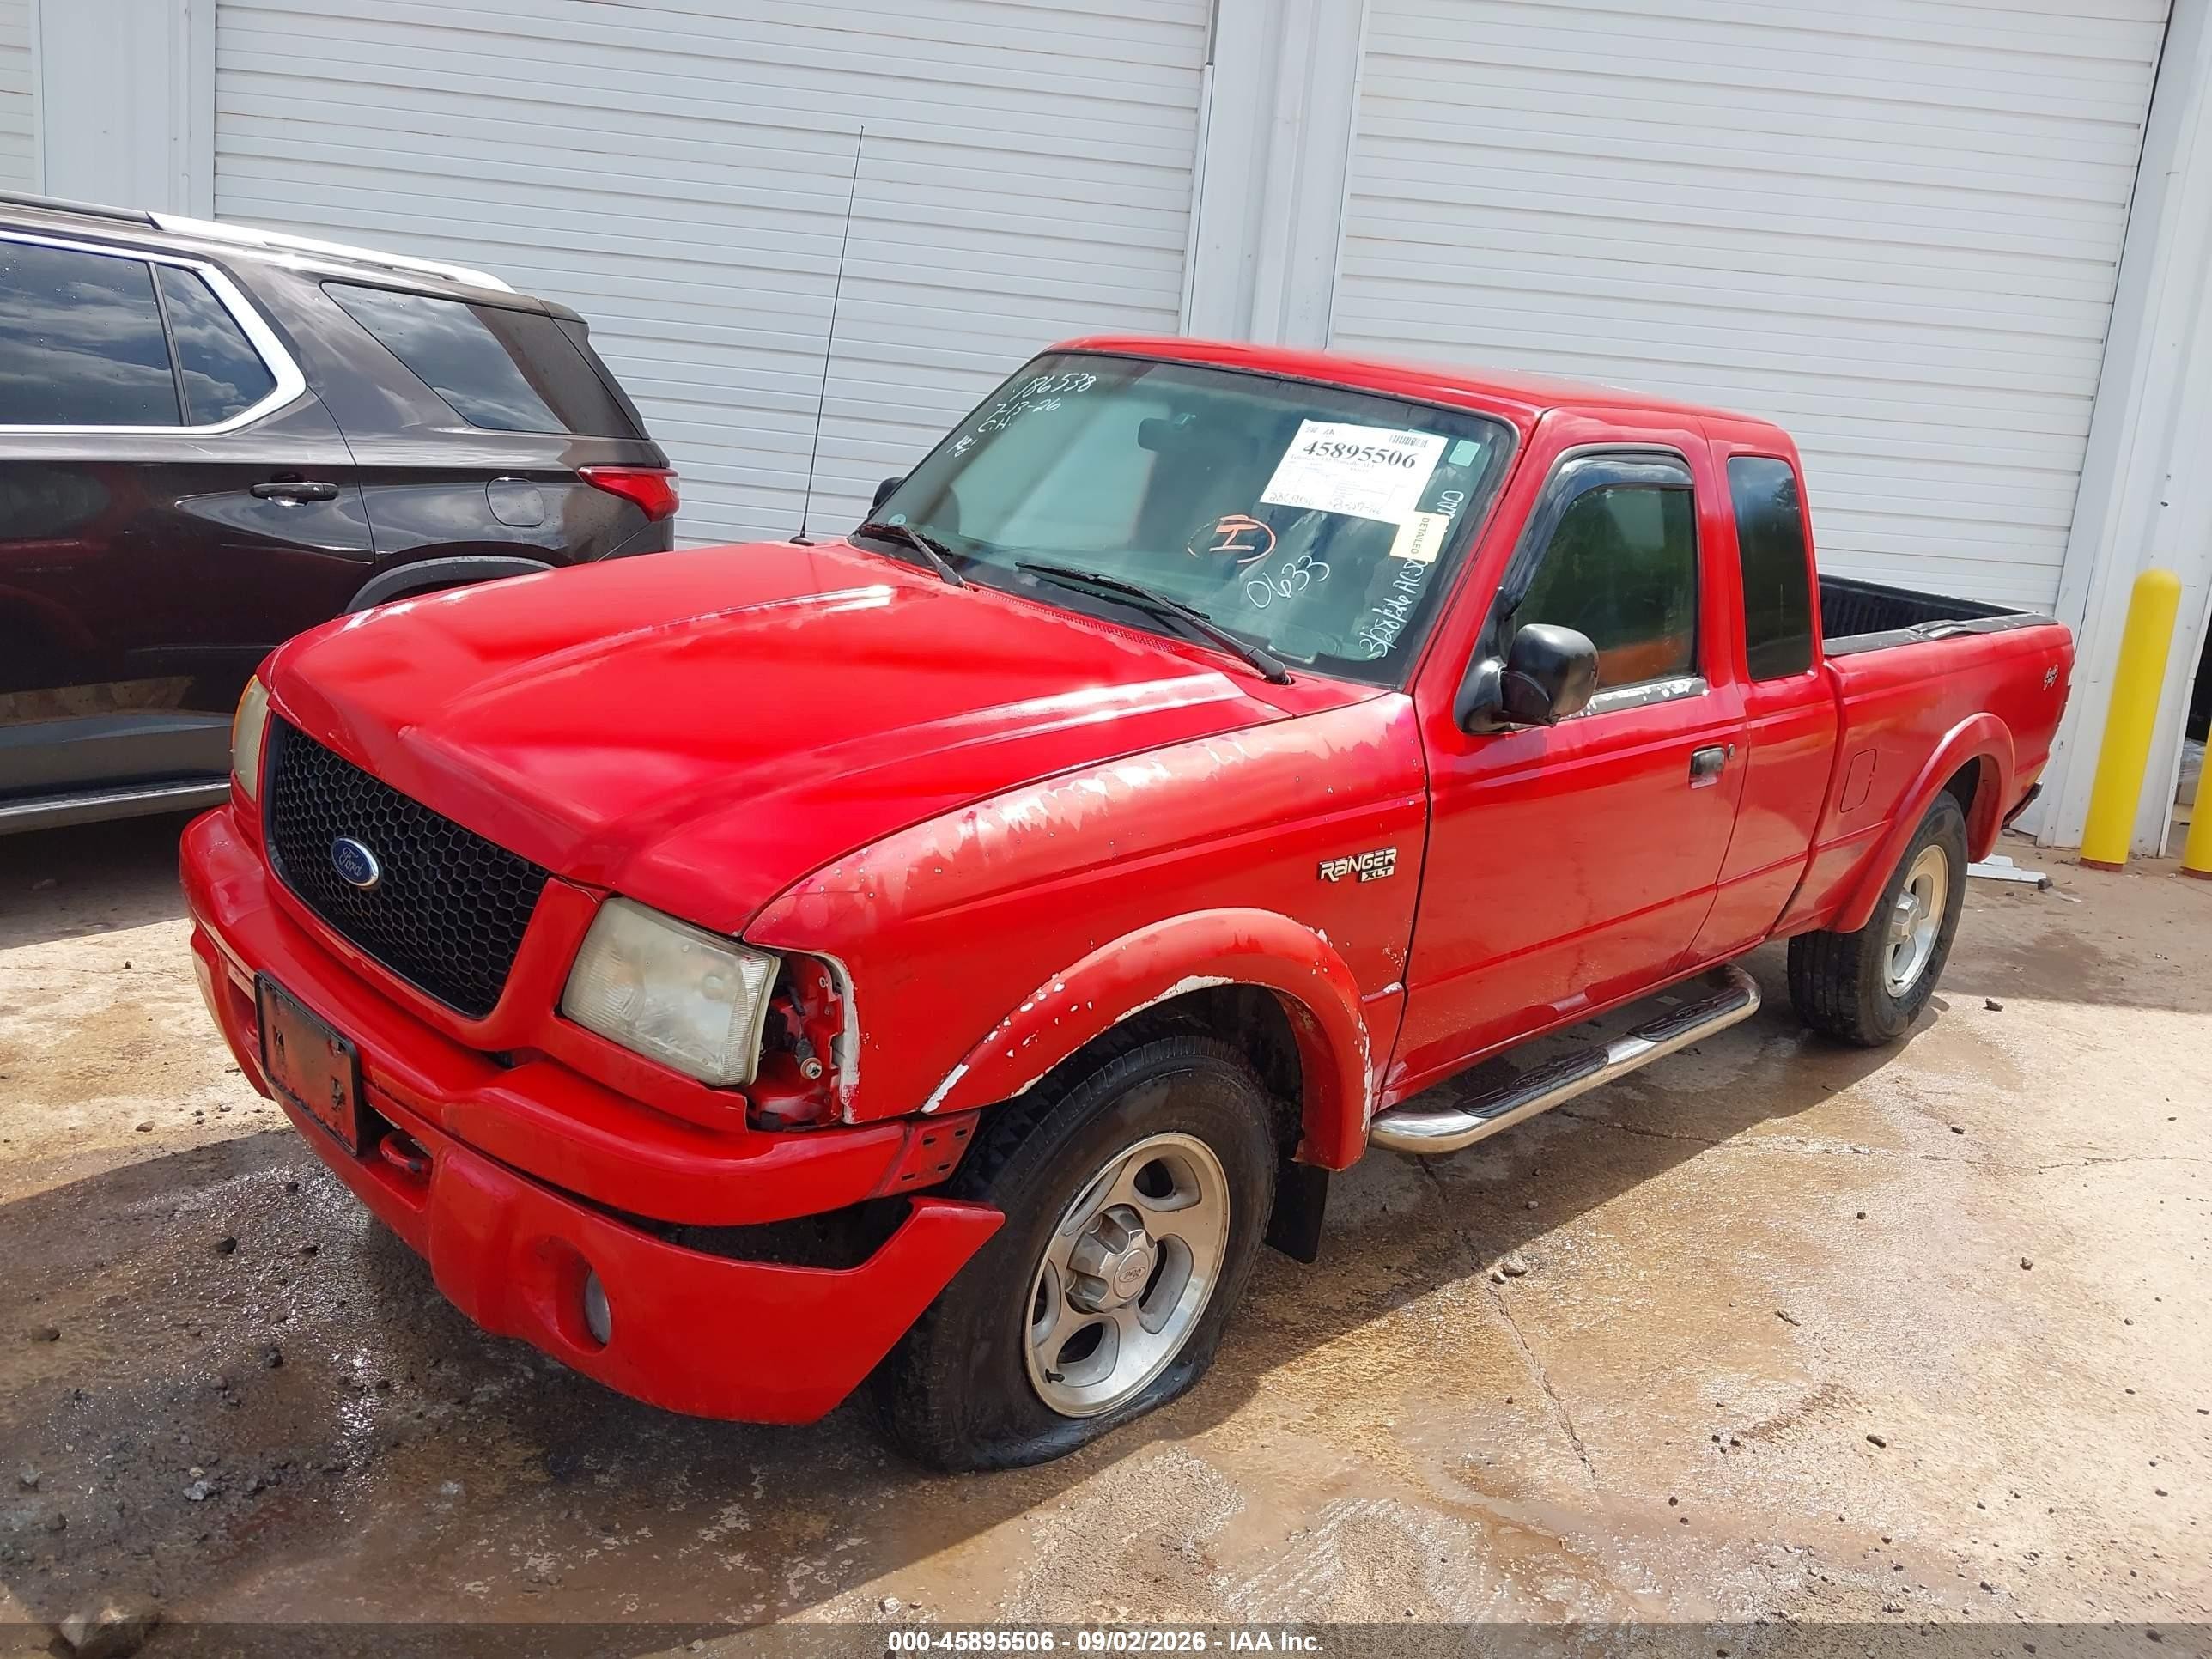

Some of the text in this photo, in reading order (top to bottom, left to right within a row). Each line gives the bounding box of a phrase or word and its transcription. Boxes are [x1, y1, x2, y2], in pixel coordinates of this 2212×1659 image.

[1303, 440, 1419, 470] 45895506
[1410, 516, 1431, 556] DETAILED
[1245, 554, 1331, 609] 0633
[1319, 847, 1398, 882] RANGER
[1364, 866, 1392, 880] XLT
